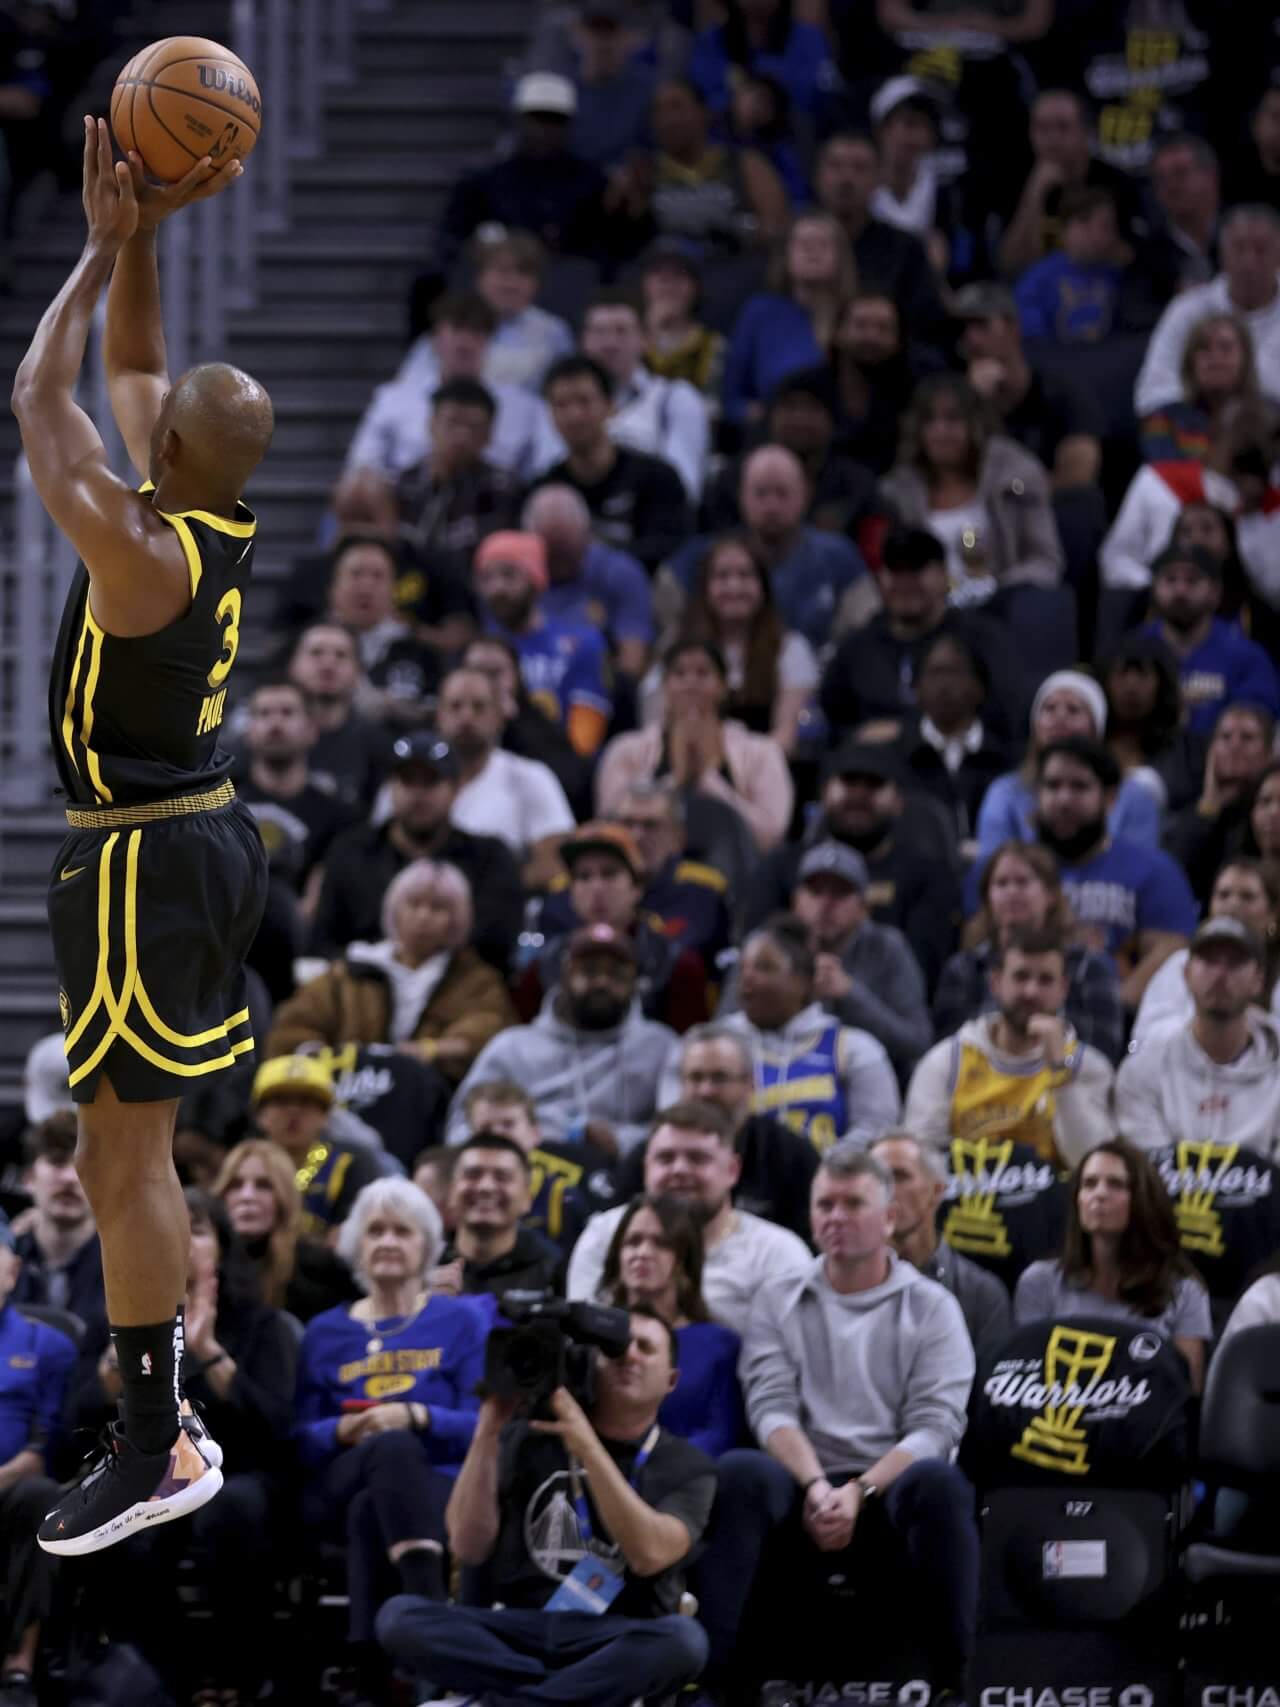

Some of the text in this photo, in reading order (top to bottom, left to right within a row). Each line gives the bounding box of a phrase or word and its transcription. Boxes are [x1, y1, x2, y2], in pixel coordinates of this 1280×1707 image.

[197, 64, 261, 113] Wilso
[207, 587, 241, 688] 3
[984, 1371, 1151, 1409] Warriors
[1065, 1502, 1093, 1516] 127
[980, 1686, 1112, 1707] CHASE
[1201, 1685, 1280, 1707] CHA
